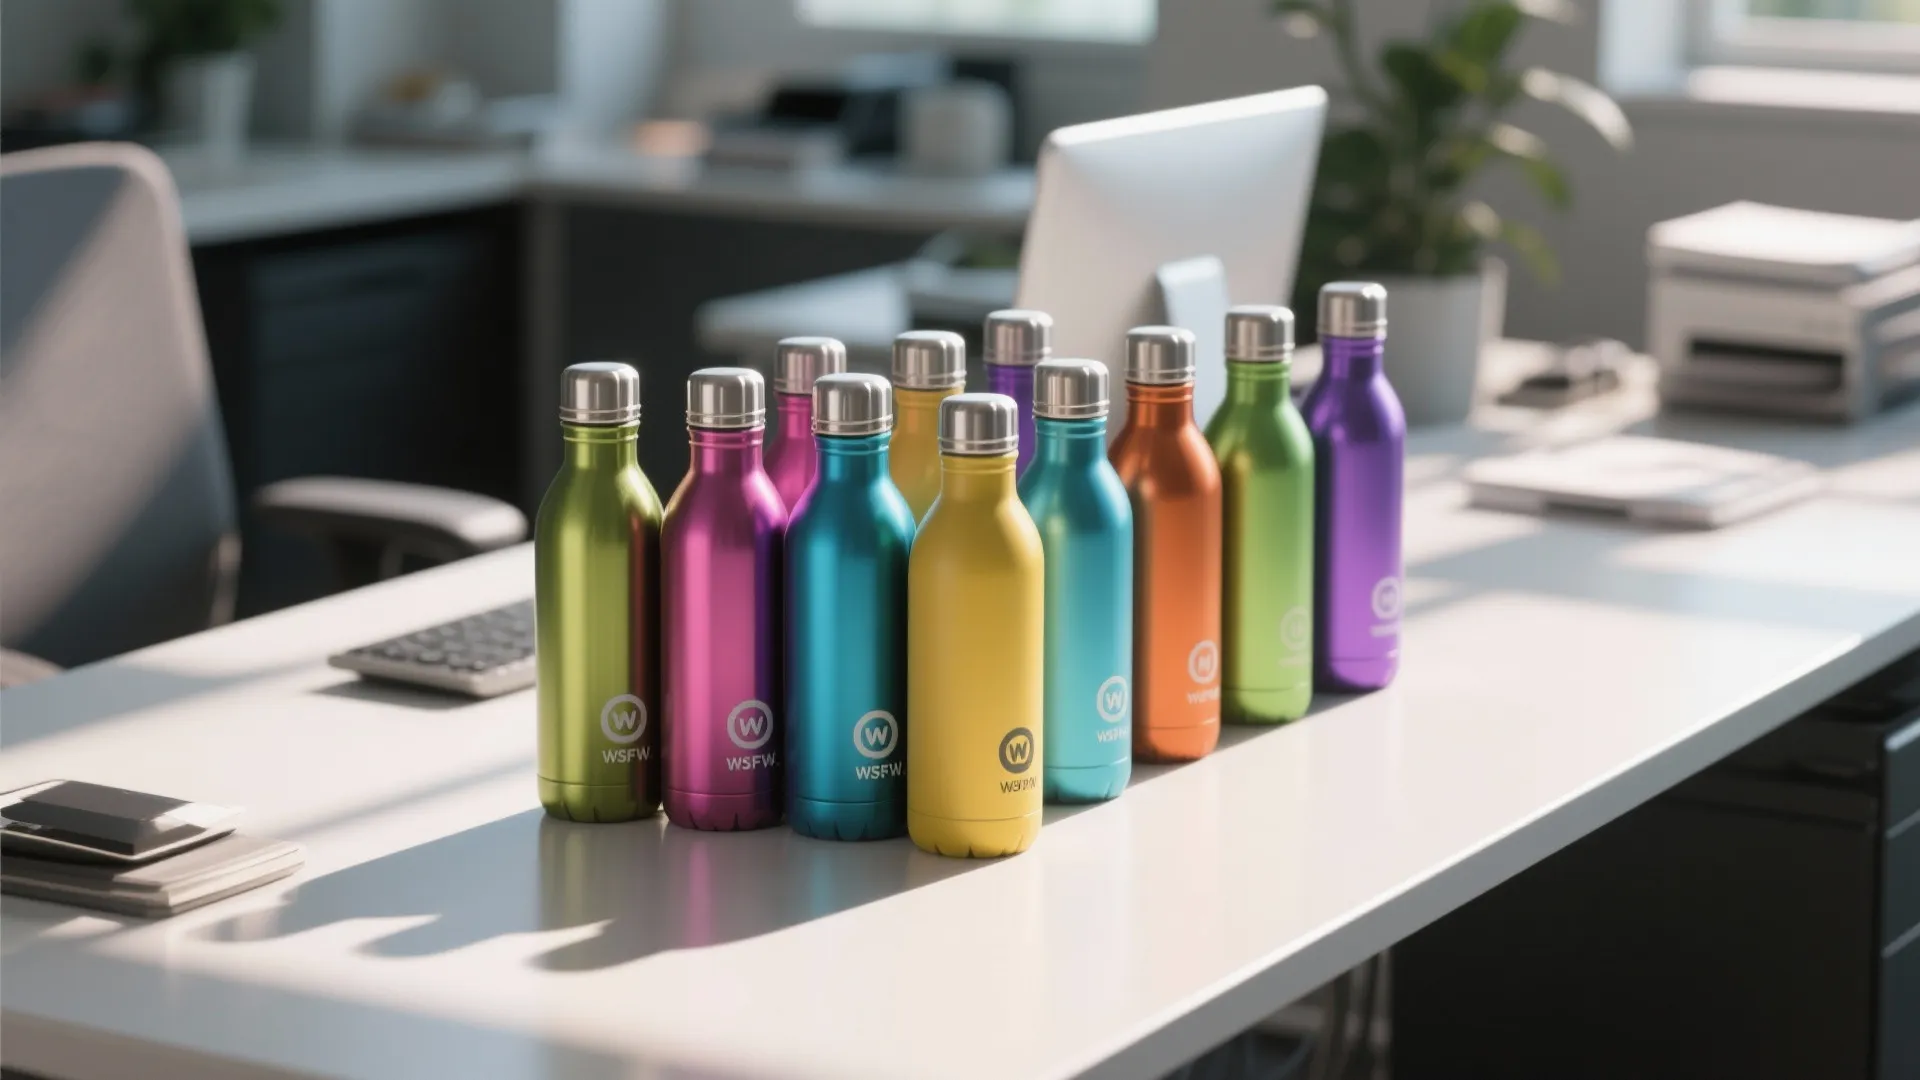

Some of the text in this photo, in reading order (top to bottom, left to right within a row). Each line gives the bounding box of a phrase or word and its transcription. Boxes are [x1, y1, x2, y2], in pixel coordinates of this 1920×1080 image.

[602, 746, 650, 763] WSFW
[726, 751, 776, 771] WSFW
[855, 761, 902, 780] WSFW
